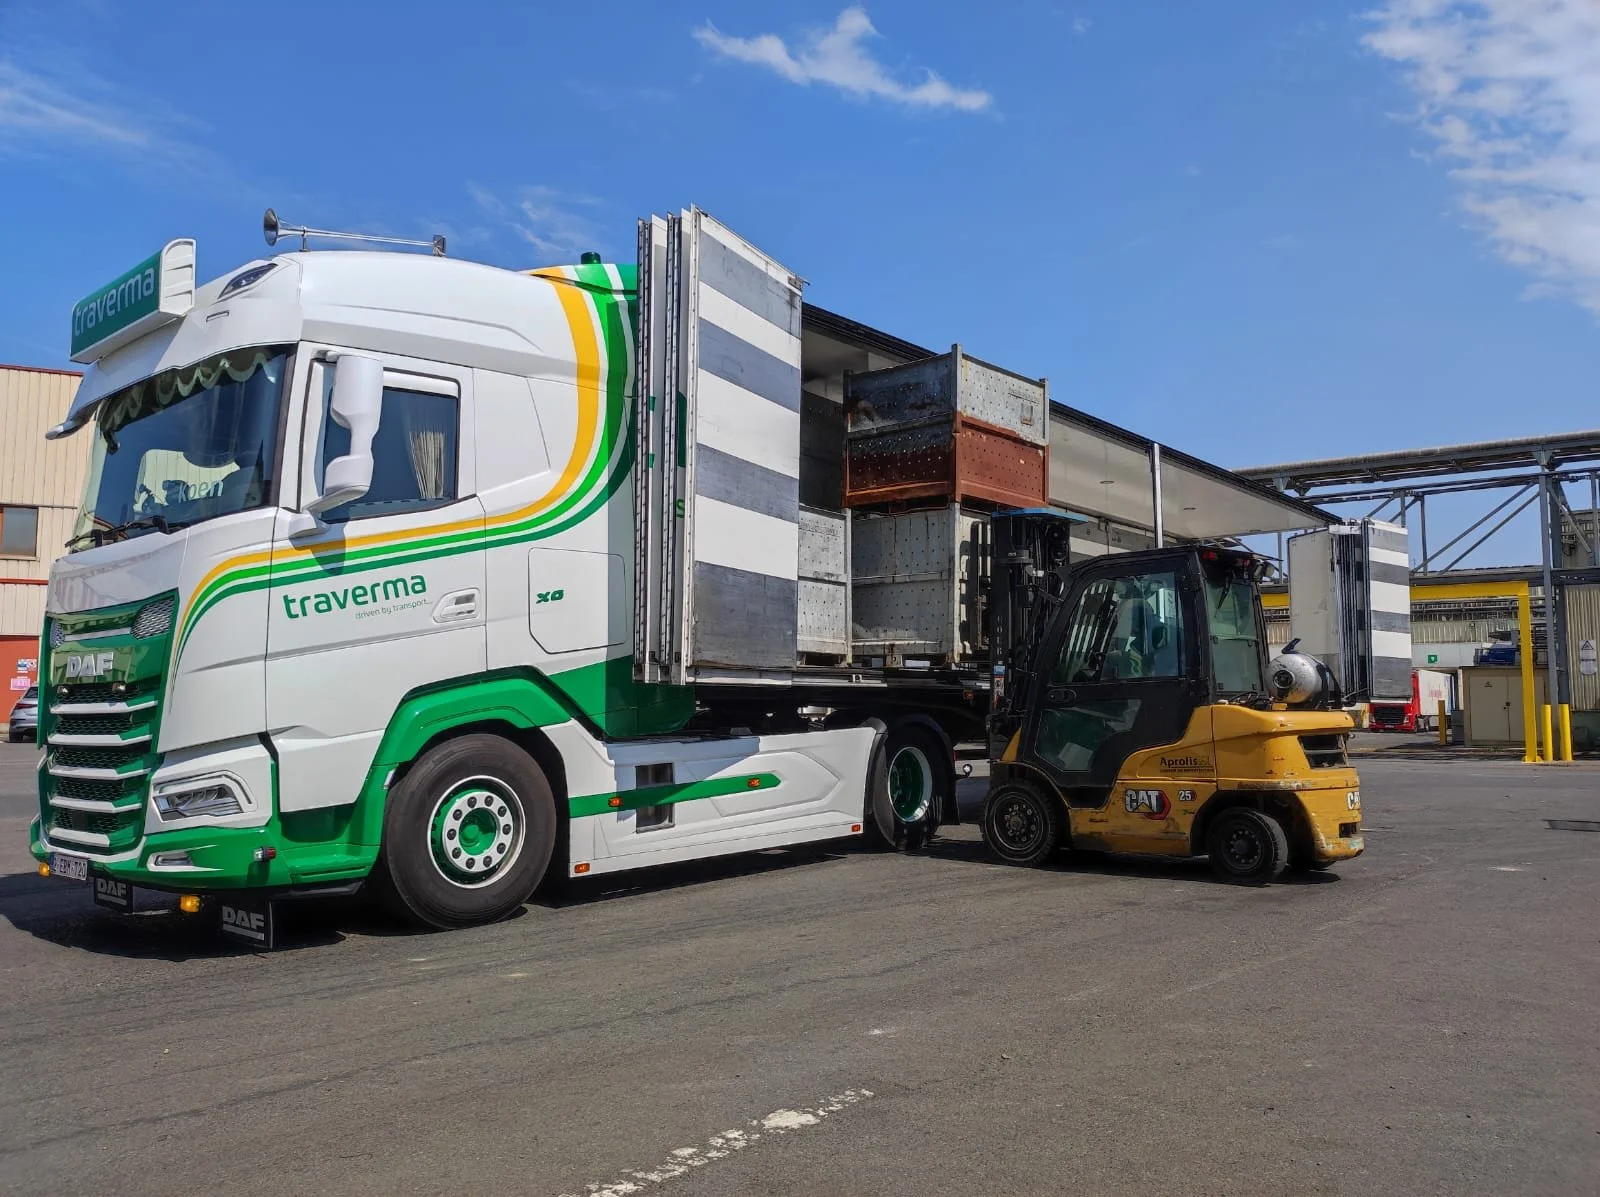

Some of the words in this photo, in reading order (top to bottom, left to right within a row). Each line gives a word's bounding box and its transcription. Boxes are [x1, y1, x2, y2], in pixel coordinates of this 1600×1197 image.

[74, 267, 155, 337] traverma
[282, 574, 427, 619] traverma
[355, 609, 380, 619] driven
[381, 606, 392, 614] by
[65, 651, 114, 678] DAF
[1160, 756, 1198, 769] Aprolis
[1125, 789, 1159, 813] CAT
[1178, 790, 1192, 801] 25
[1347, 791, 1360, 810] CA
[97, 878, 127, 897] DAF
[222, 905, 265, 930] DAF
